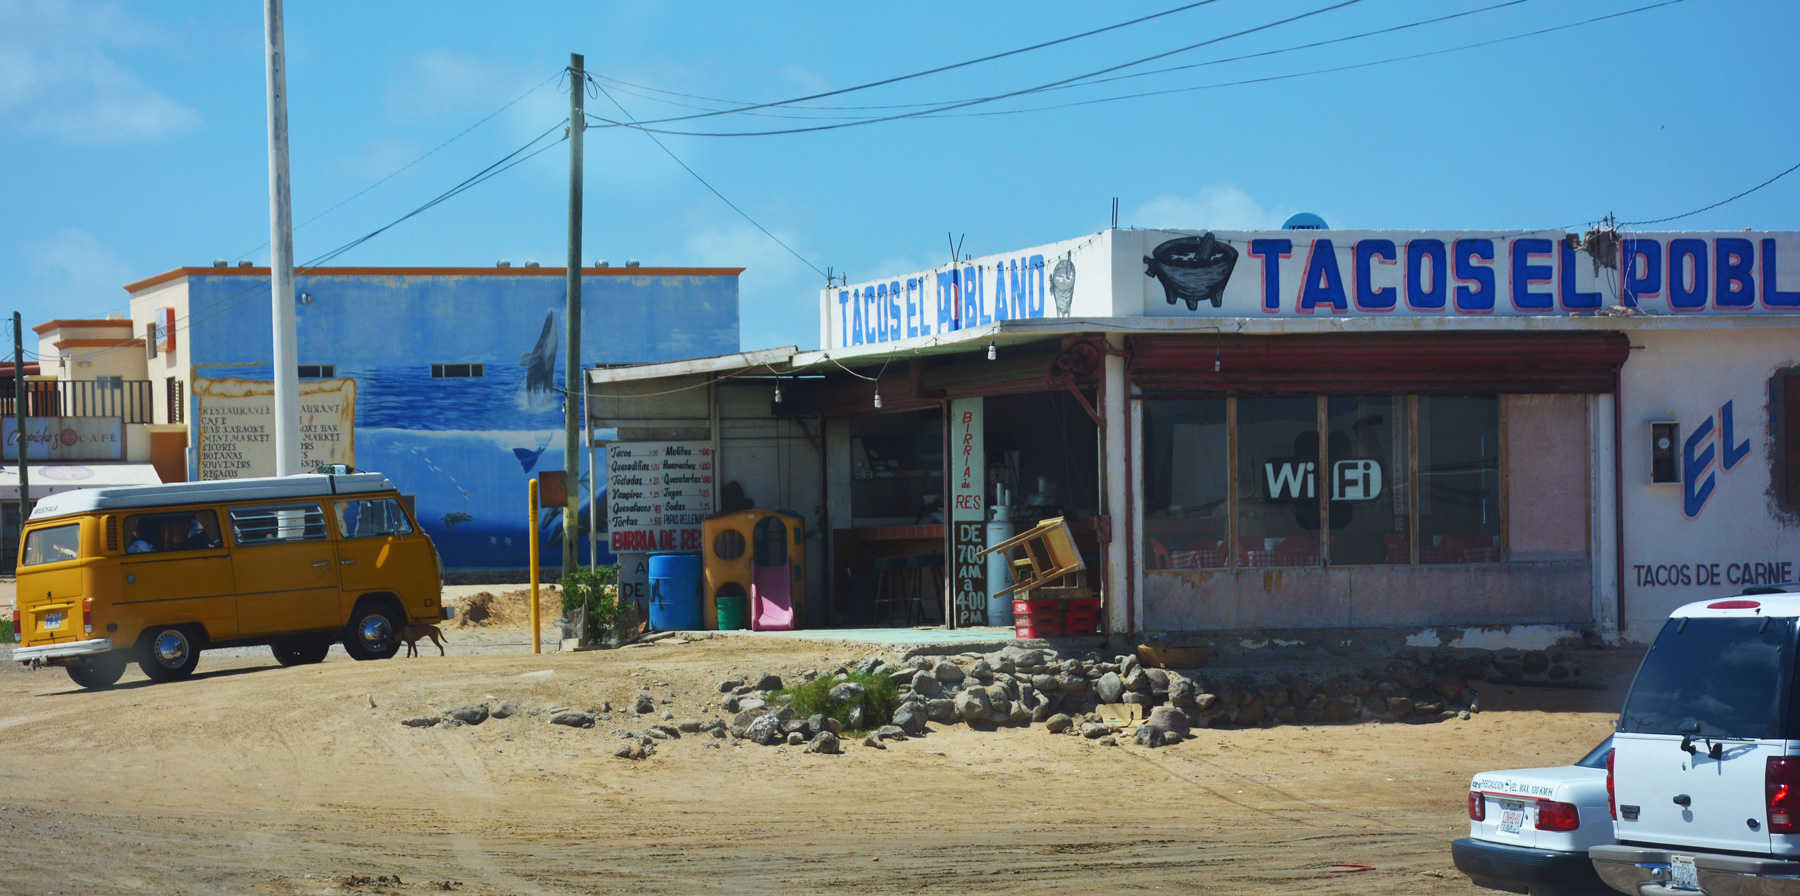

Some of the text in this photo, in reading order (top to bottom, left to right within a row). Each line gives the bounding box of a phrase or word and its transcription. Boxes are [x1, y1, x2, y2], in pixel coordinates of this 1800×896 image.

[1247, 237, 1800, 314] TACOS EL POBL
[838, 254, 1045, 348] TACOS EL POBLANO
[202, 404, 340, 416] RESTAURANTE AURANT
[201, 416, 227, 427] CAFE
[202, 425, 265, 435] BAR KARAOKE
[320, 424, 338, 433] BAR
[202, 434, 270, 443] MINI MARKET
[303, 433, 341, 442] MARKET
[202, 443, 237, 452] LICORES
[962, 411, 973, 478] BIRRIA
[202, 452, 243, 460] BOTANAS
[610, 446, 632, 458] Tacos
[665, 446, 692, 456] Mulitas
[202, 460, 251, 469] SOUVENIRS
[662, 459, 696, 470] Huaraches
[1681, 399, 1751, 521] EL
[611, 460, 650, 473] Quesadillas
[202, 470, 238, 479] REGALOS
[610, 474, 643, 486] Tostadas
[663, 473, 701, 485] Quesatortas
[1264, 461, 1374, 499] Wi Fi
[961, 478, 971, 489] de
[612, 488, 643, 500] Vampiros
[664, 501, 686, 511] Sodas
[955, 494, 981, 510] RES
[612, 502, 652, 515] Quesatacos
[612, 515, 638, 528] Tortas
[663, 514, 679, 525] PAPAS
[960, 524, 982, 542] DE
[611, 529, 658, 551] BIRRIA
[660, 528, 677, 550] DE
[1633, 562, 1793, 587] TACOS DE CARNE
[622, 582, 645, 598] DE
[963, 579, 974, 592] a
[956, 591, 986, 611] 4:00
[1481, 779, 1504, 790] PRECAUCION
